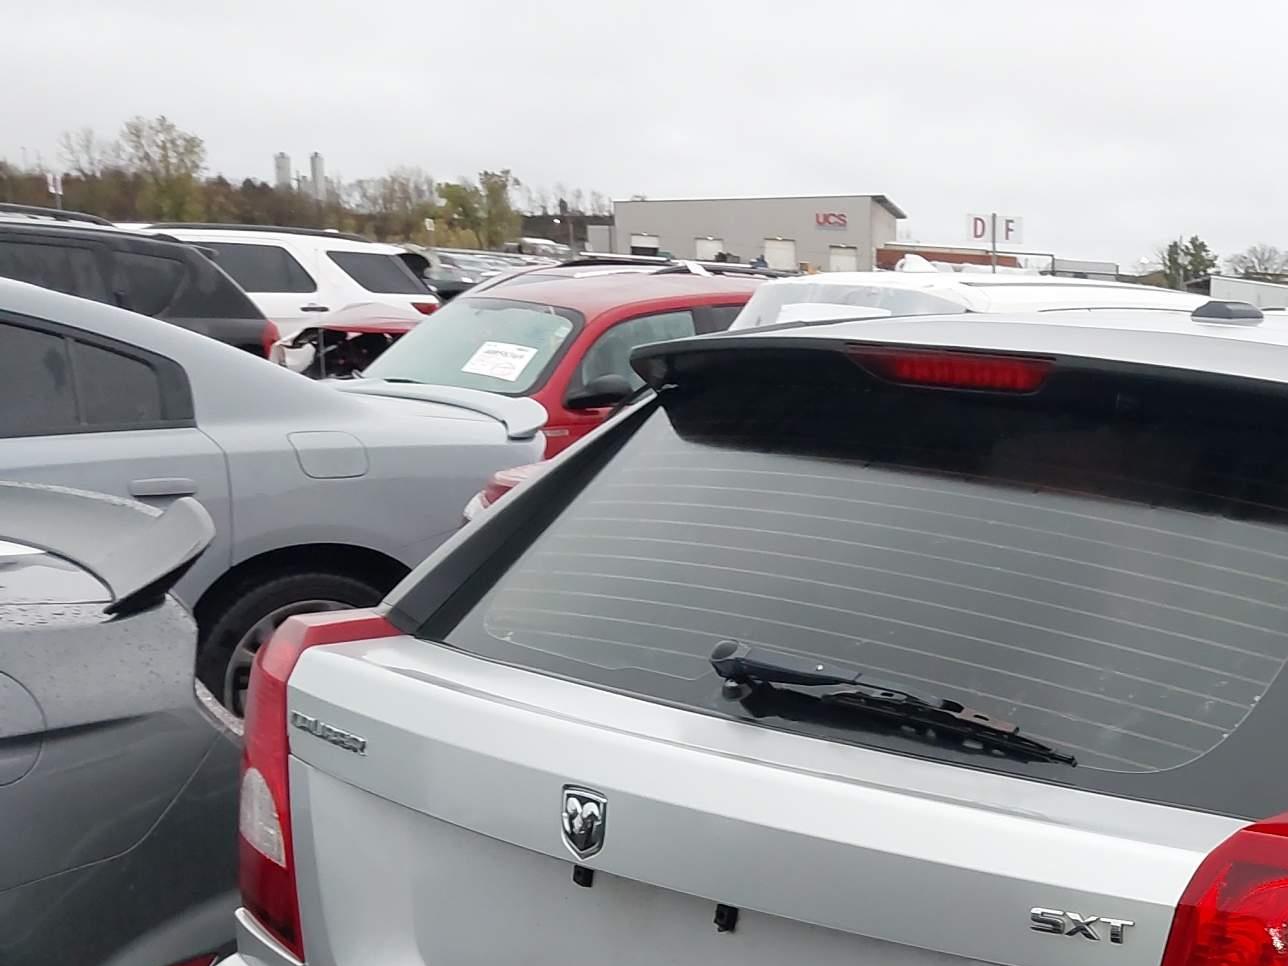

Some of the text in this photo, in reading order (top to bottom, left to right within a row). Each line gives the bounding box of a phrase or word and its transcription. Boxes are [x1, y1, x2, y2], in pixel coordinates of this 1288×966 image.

[815, 212, 848, 226] UCS
[973, 217, 1015, 241] D F
[1029, 906, 1136, 944] SXT
